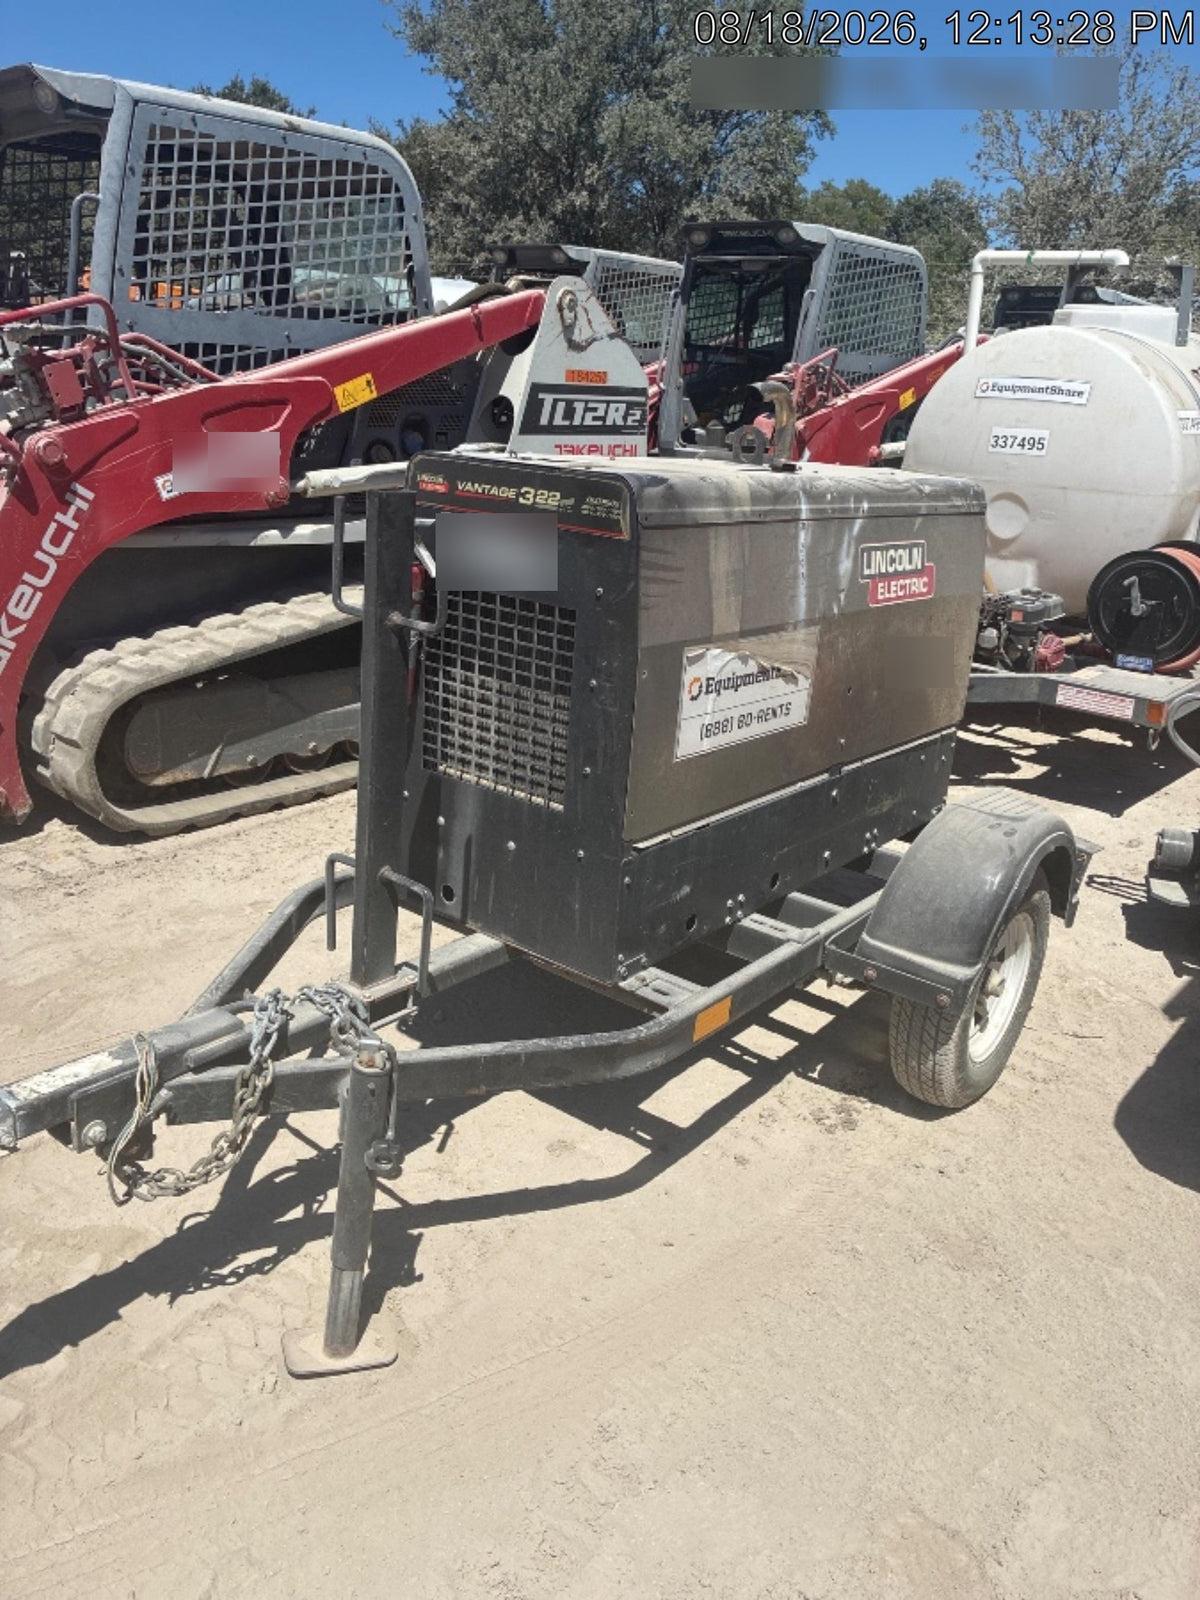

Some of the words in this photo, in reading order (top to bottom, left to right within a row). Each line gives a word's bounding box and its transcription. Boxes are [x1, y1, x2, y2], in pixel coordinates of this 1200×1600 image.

[990, 382, 1085, 399] EquipmentShare
[990, 435, 1046, 451] 337495
[456, 480, 519, 499] VANTAGE
[519, 486, 561, 506] 322
[862, 546, 922, 575] LINCOLN
[0, 481, 95, 676] KEUCHI
[877, 577, 929, 600] ELECTRIC
[704, 665, 782, 696] Equipment
[700, 716, 734, 740] (888)
